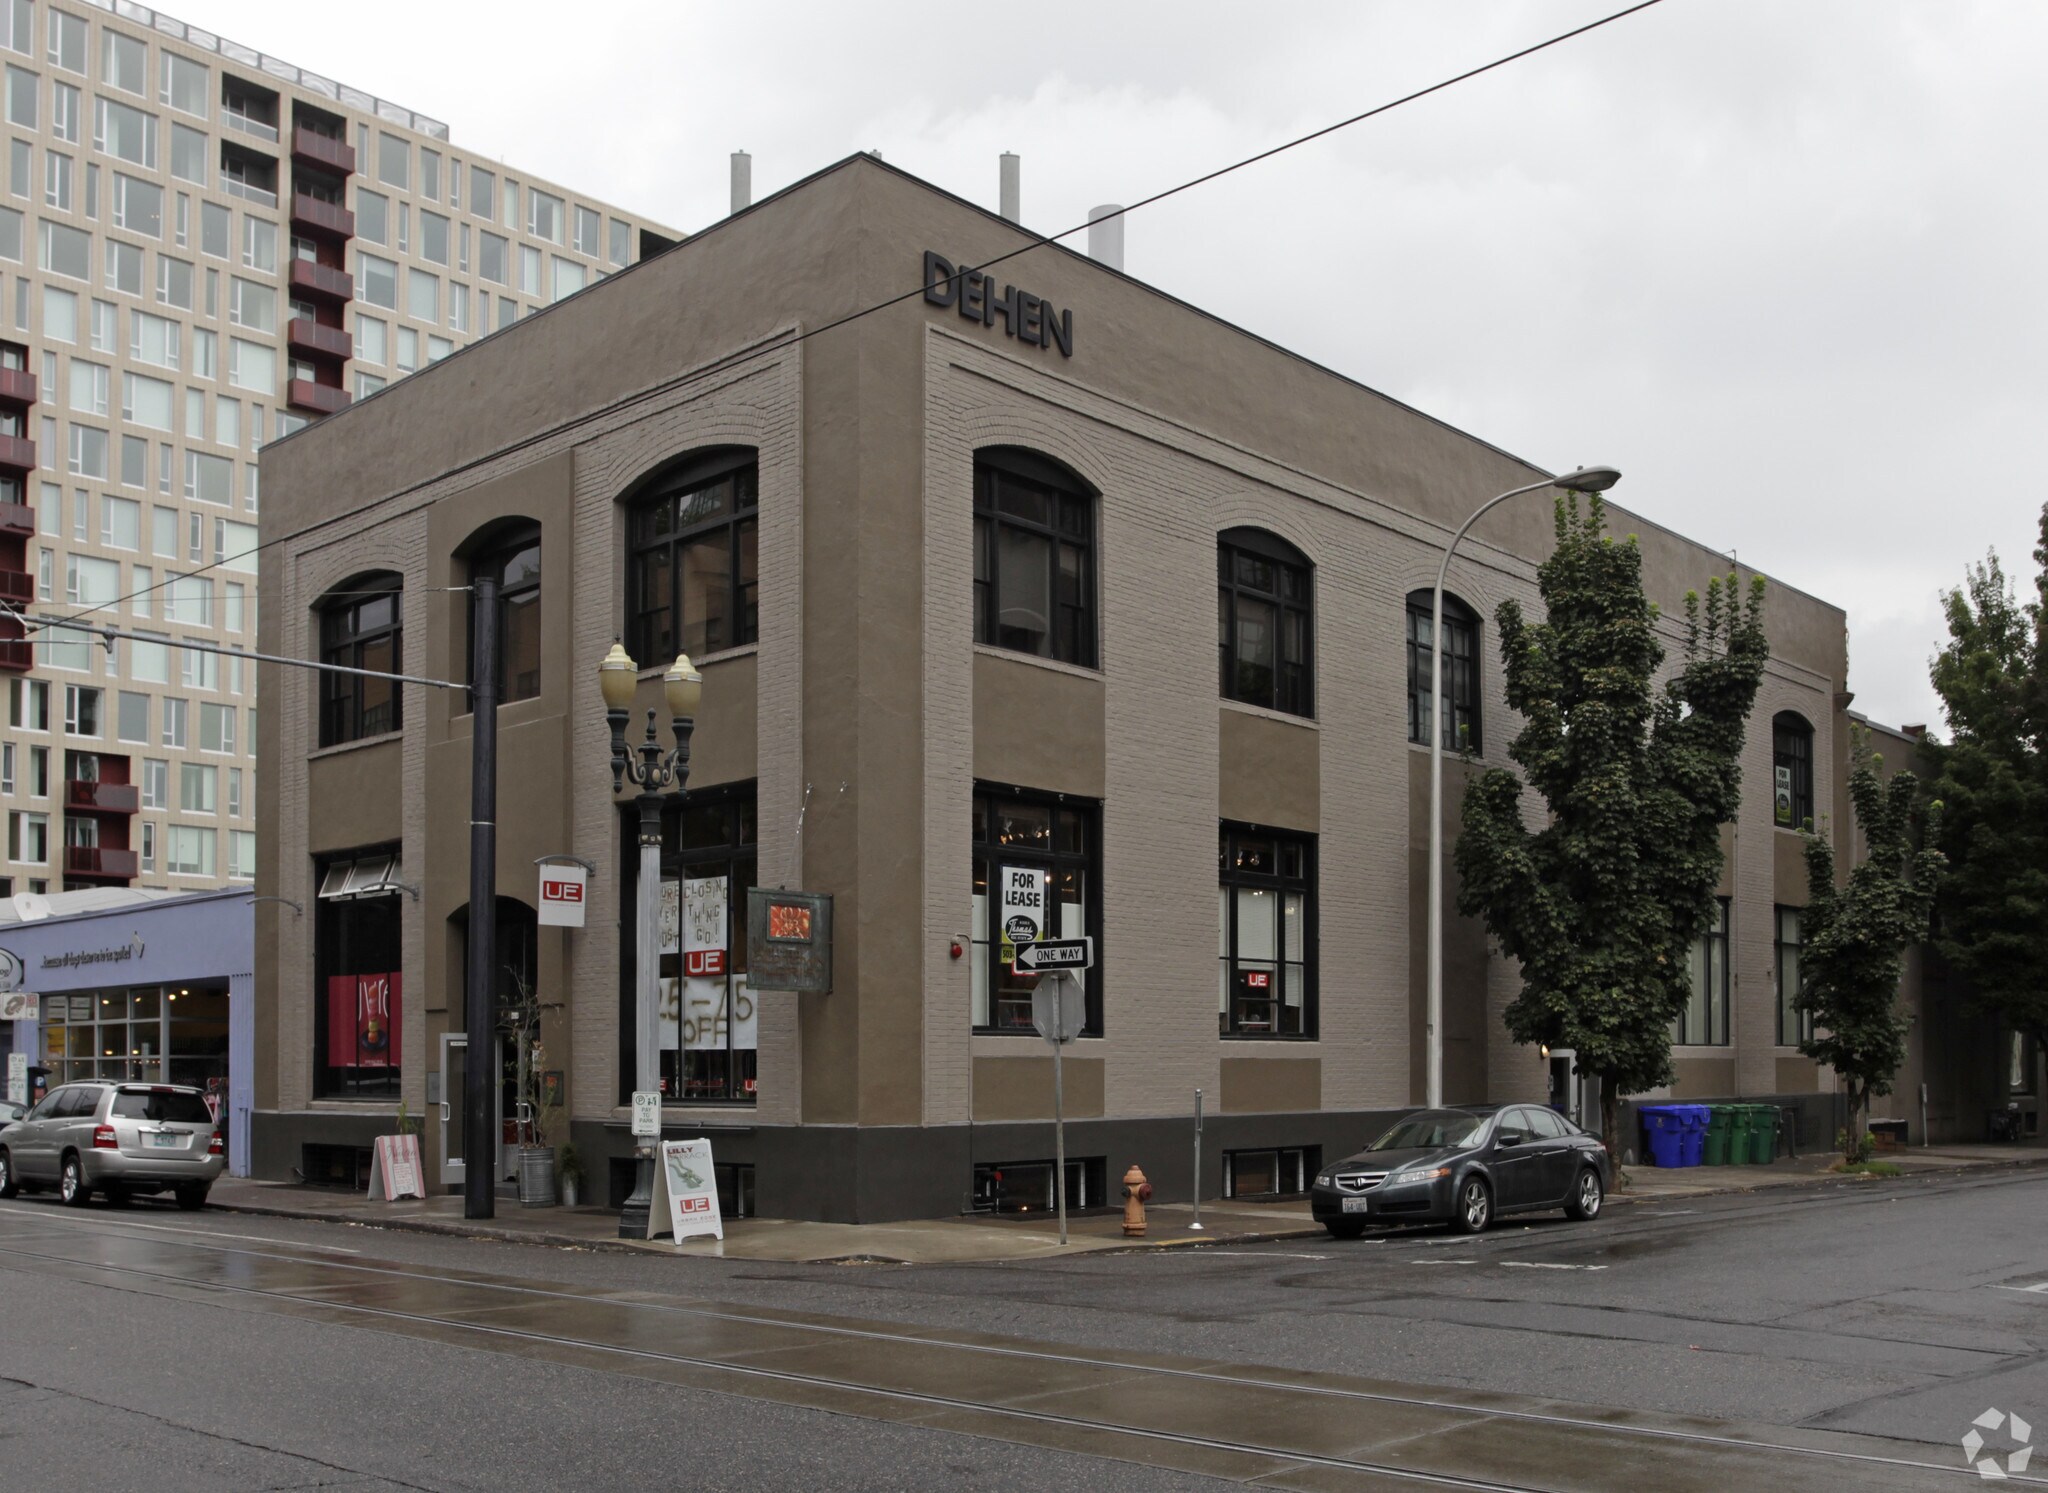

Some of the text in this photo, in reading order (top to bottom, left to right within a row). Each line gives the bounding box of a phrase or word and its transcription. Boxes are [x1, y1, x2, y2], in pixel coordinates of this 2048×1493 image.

[924, 250, 1073, 357] DEHEN
[1012, 872, 1034, 889] FOR
[546, 882, 579, 900] UE
[1005, 890, 1040, 907] LEASE
[661, 928, 679, 948] UST
[689, 951, 720, 973] UE
[1037, 948, 1080, 961] ONE WAY
[1249, 974, 1267, 986] UE
[684, 1016, 728, 1045] OFF
[667, 1146, 693, 1154] LILLY
[682, 1199, 708, 1213] UE
